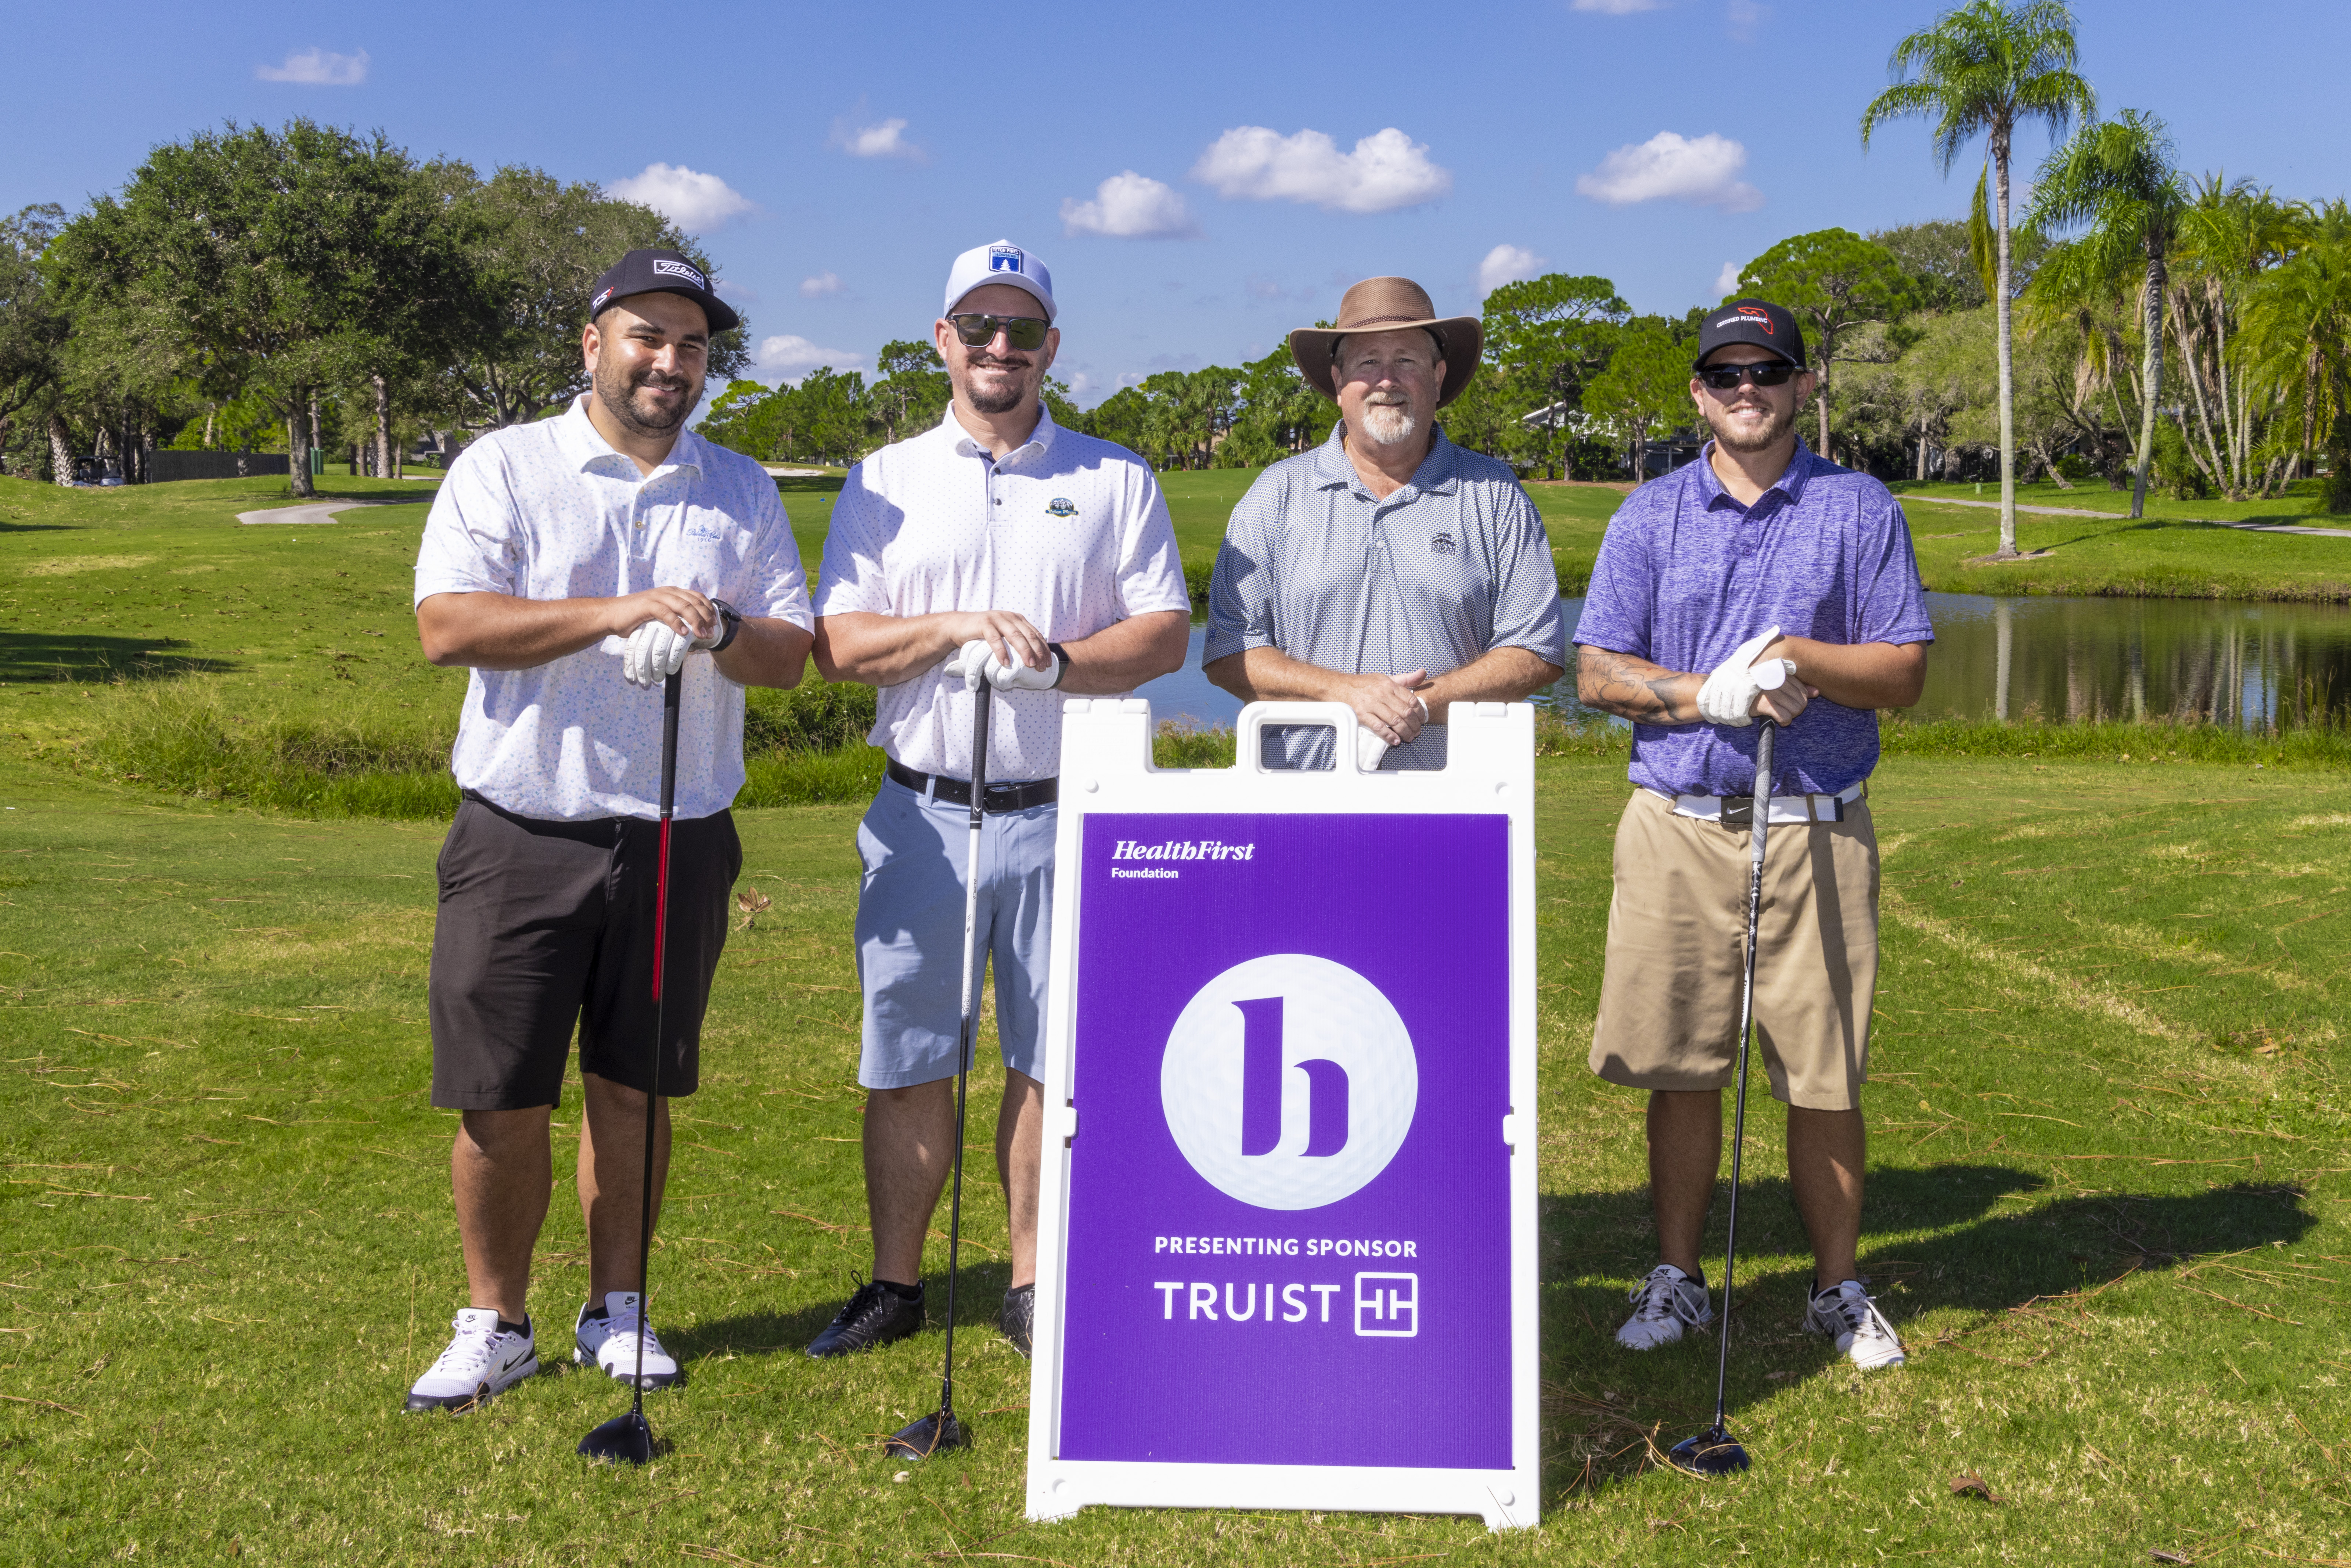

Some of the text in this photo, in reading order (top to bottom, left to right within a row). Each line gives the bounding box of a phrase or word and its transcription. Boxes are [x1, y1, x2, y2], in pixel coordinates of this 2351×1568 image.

[657, 262, 702, 284] Titleist
[1717, 316, 1768, 328] CERTIFIED PLUMBING
[1112, 840, 1255, 860] HealthFirst
[1112, 867, 1178, 878] Foundation
[1155, 1236, 1417, 1258] PRESENTING SPONSOR
[1154, 1282, 1340, 1322] TRUIST
